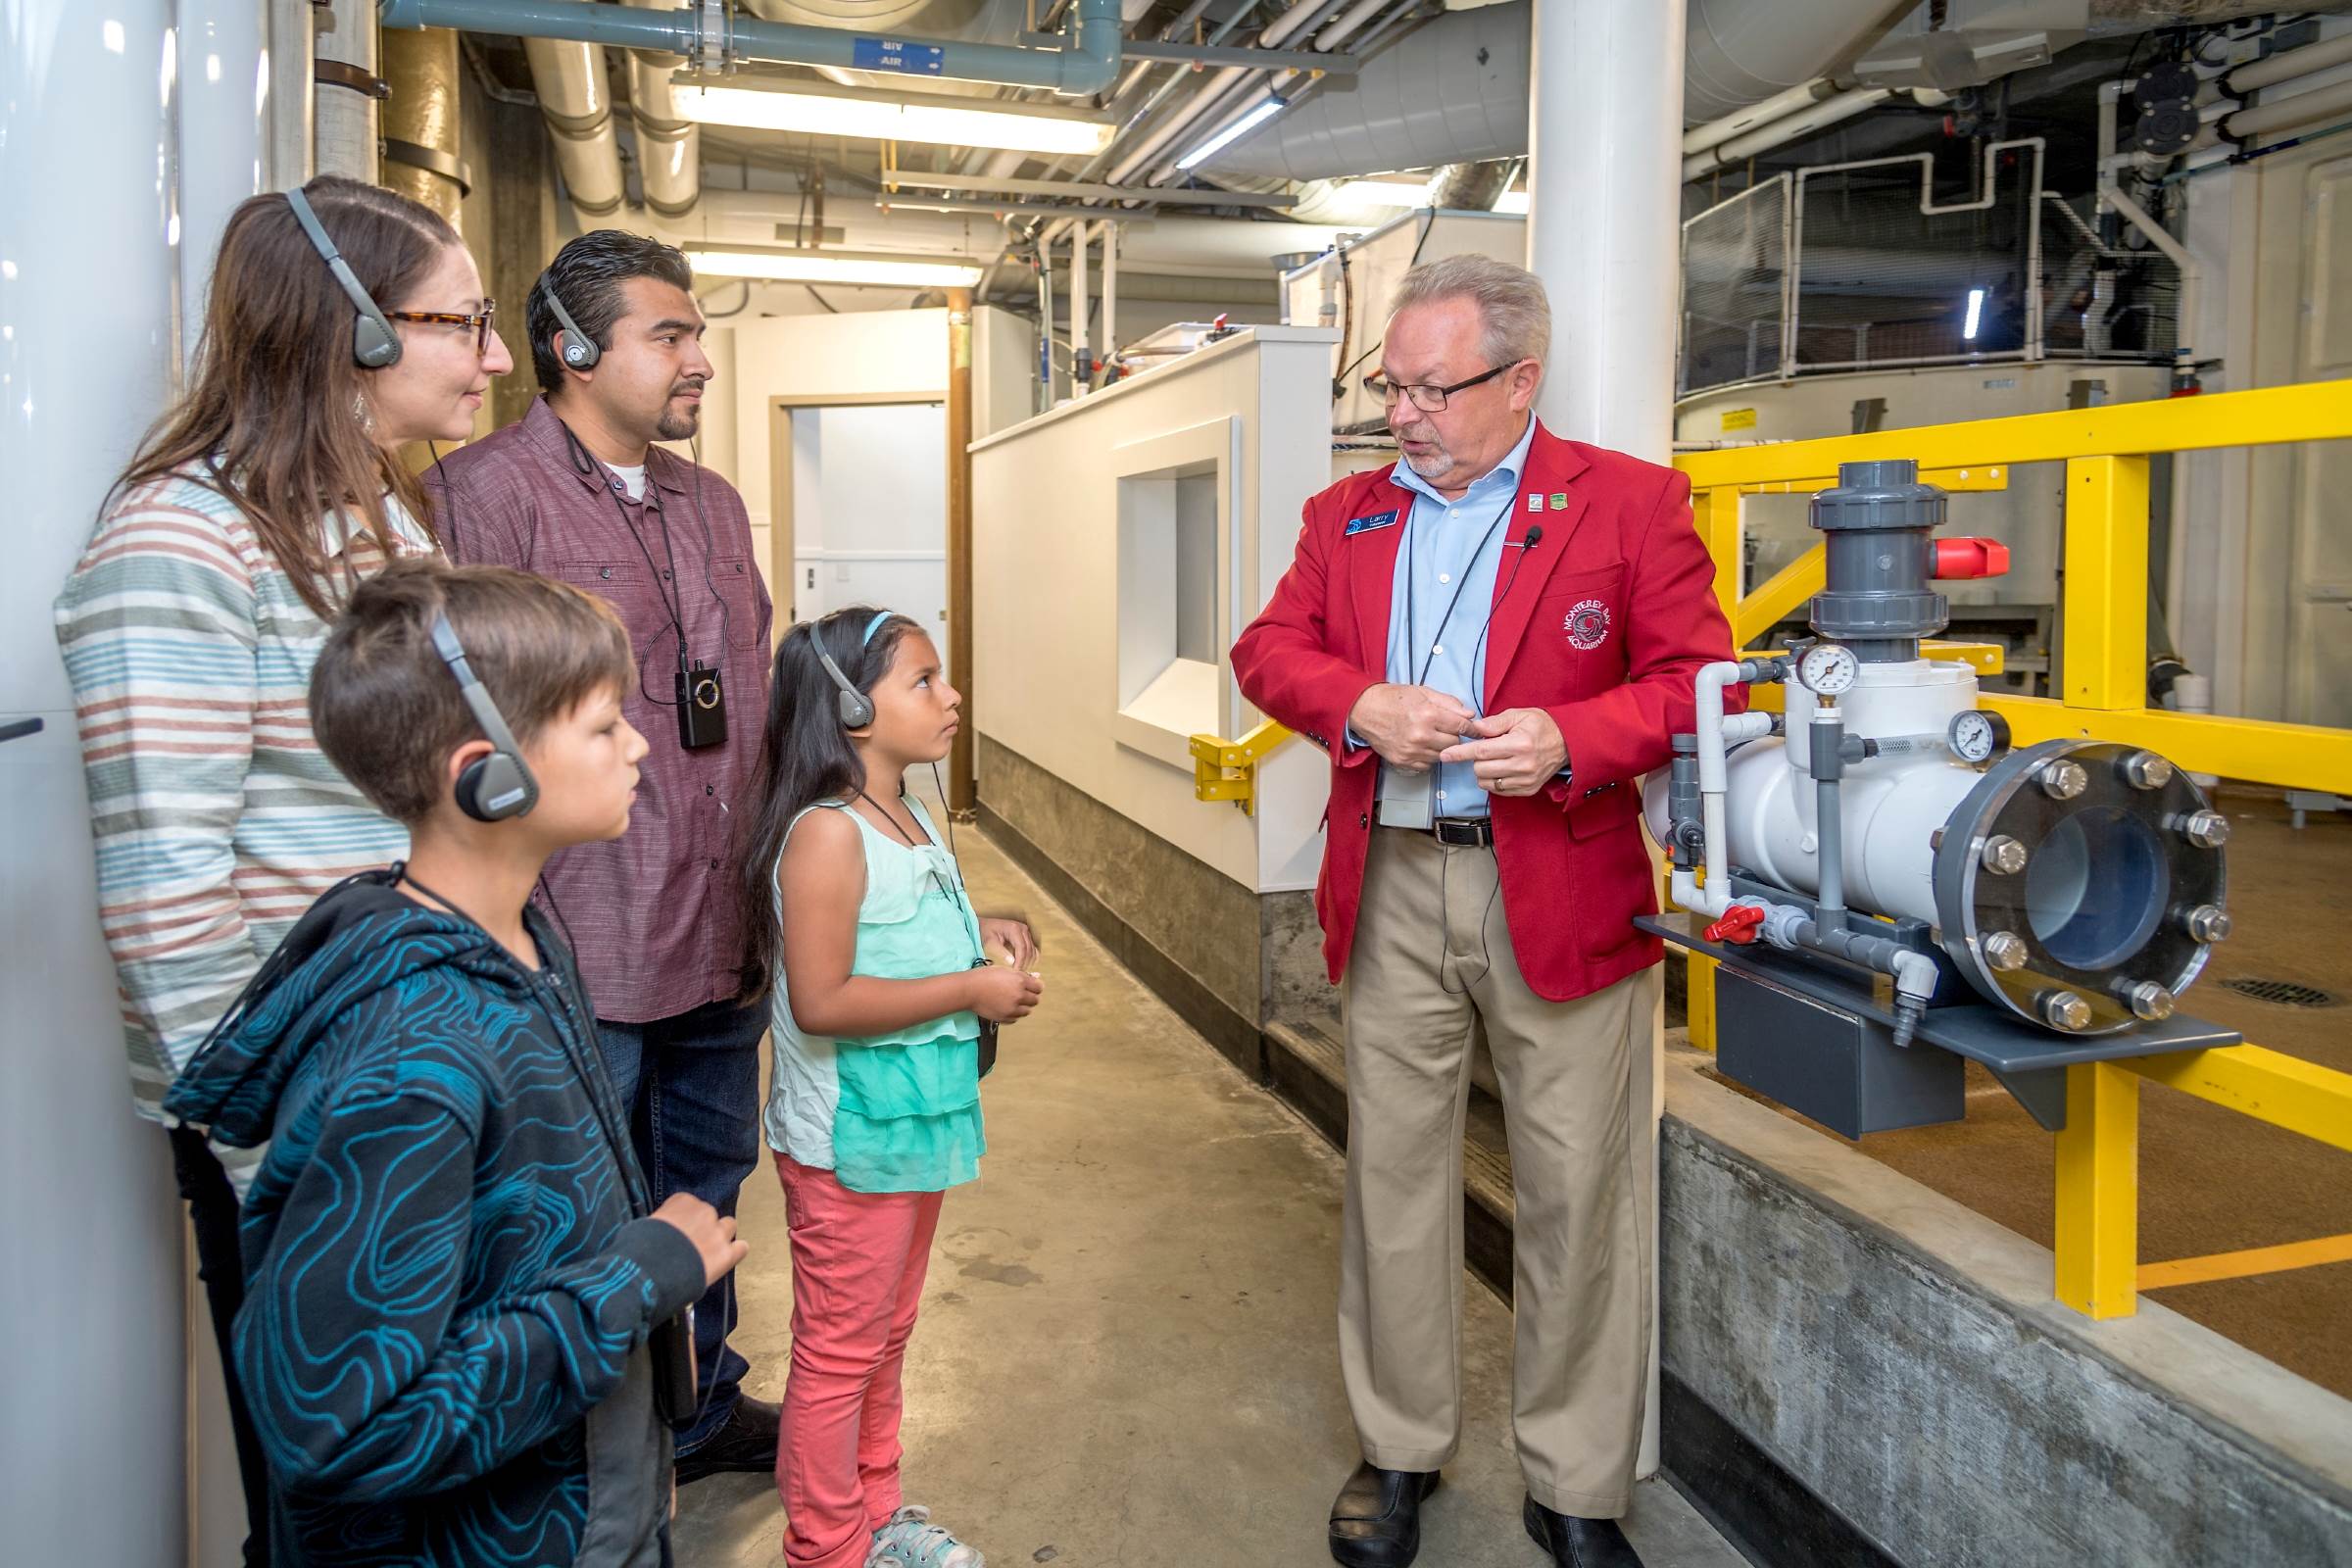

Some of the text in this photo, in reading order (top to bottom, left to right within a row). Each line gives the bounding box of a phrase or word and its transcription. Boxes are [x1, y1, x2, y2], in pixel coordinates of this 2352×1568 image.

[882, 41, 903, 51] AIR
[880, 56, 902, 67] AIR
[1369, 514, 1389, 523] Larry
[1563, 600, 1611, 630] MONTEREY BAY
[1567, 630, 1609, 650] AQUARIUM
